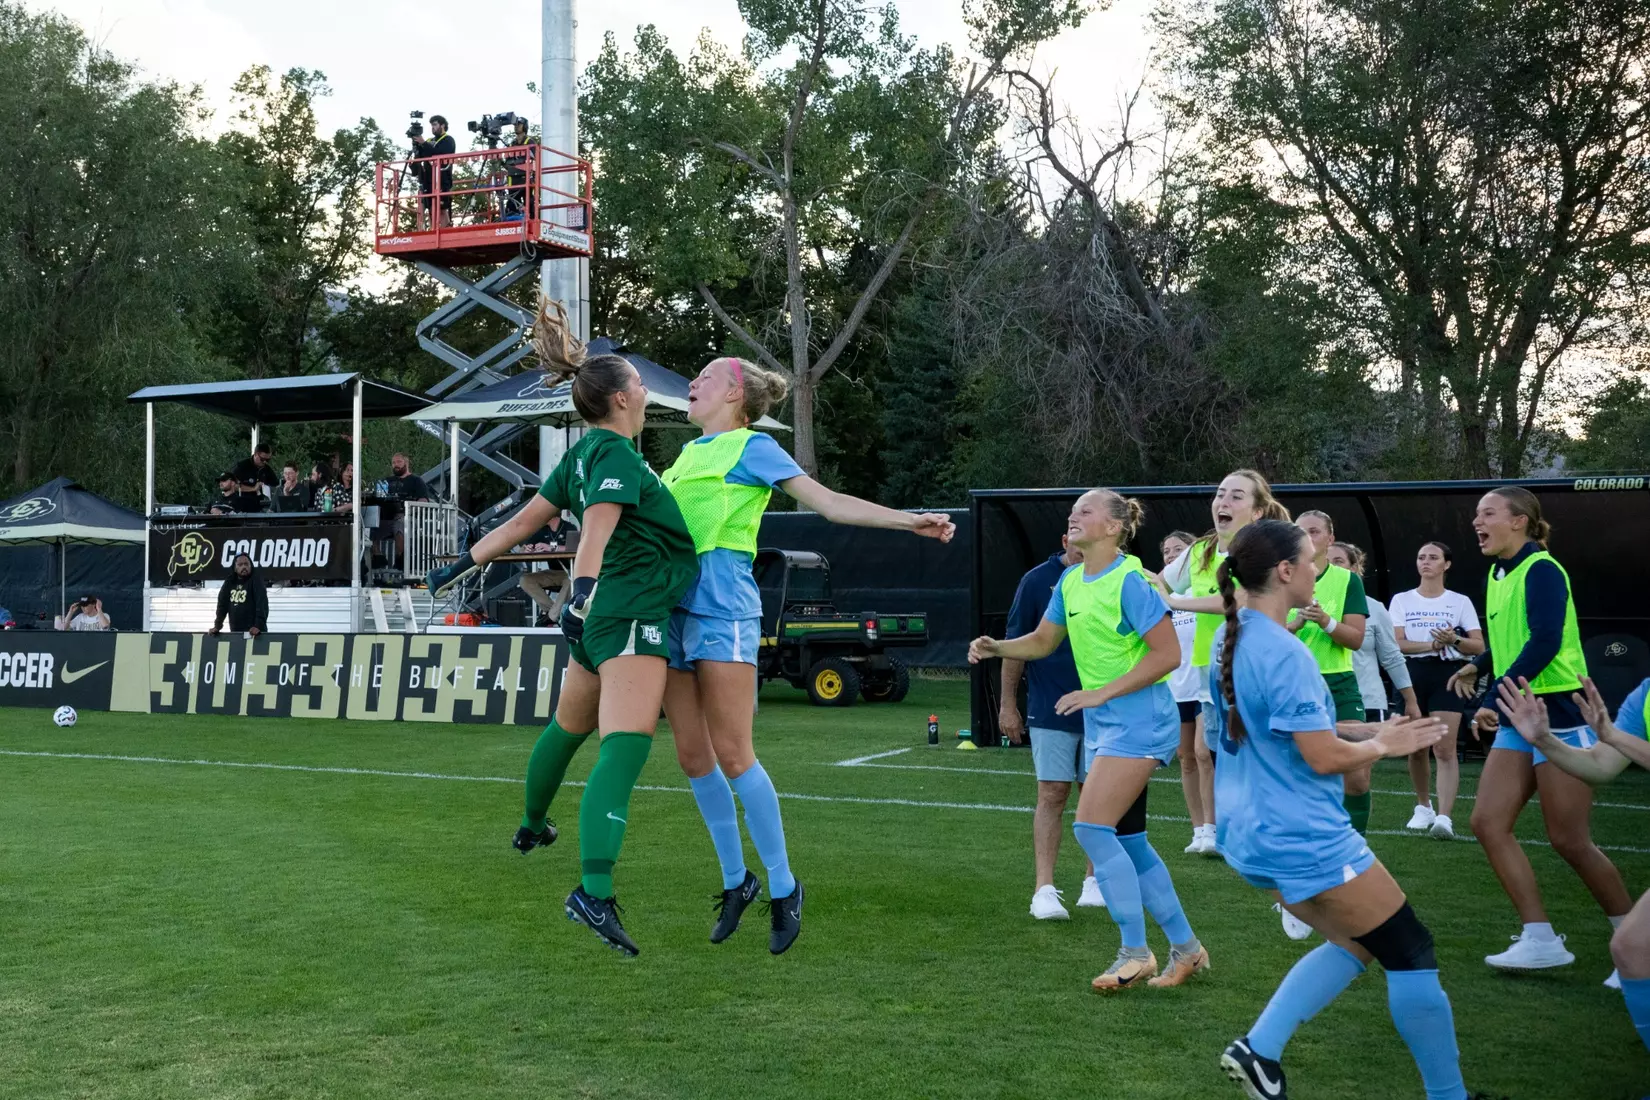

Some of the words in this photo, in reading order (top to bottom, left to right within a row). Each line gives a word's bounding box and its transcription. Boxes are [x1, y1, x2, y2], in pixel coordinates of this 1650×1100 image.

[1574, 478, 1644, 490] COLORADO
[230, 589, 247, 603] 303
[1405, 611, 1455, 619] MARQUETTE
[1174, 617, 1198, 627] OCCE
[640, 624, 662, 646] MU
[185, 661, 256, 685] HOME
[279, 662, 309, 687] OF
[333, 663, 384, 688] THE
